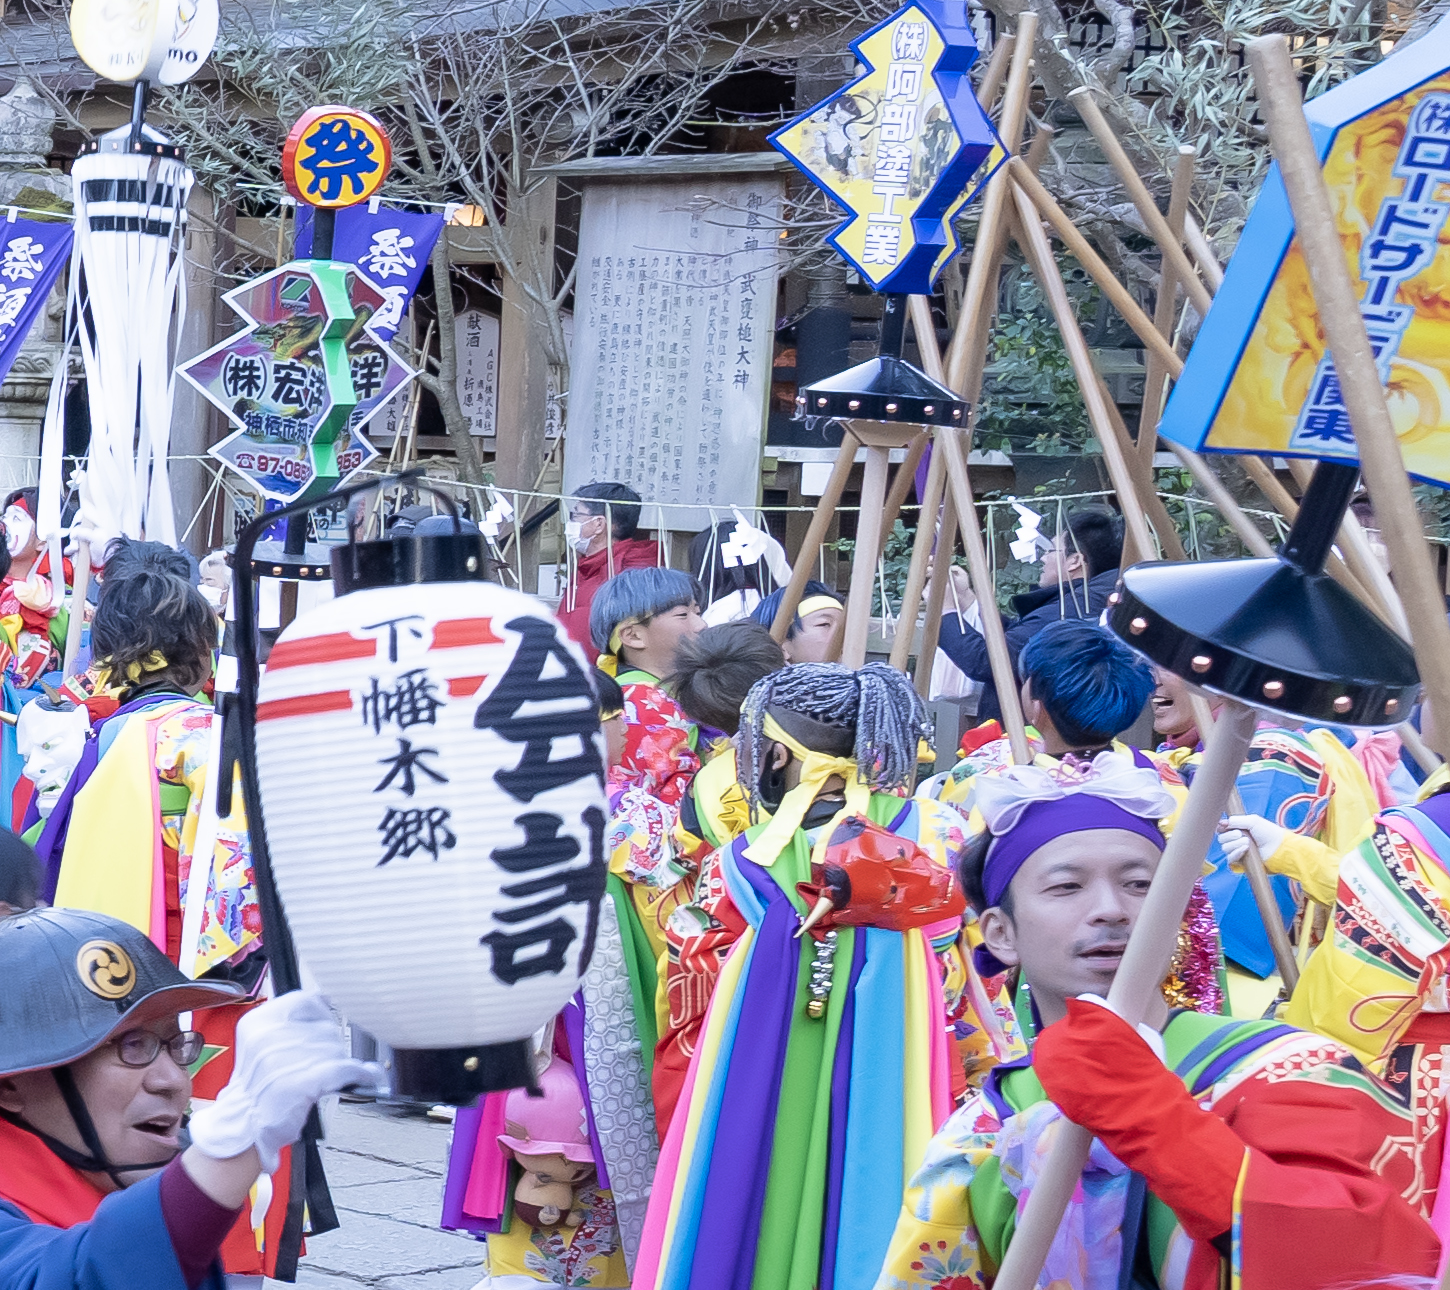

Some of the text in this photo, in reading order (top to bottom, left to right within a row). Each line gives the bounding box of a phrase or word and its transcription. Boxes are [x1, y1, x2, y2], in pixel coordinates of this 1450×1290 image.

[299, 118, 377, 199] 祭
[862, 21, 929, 265] (株)阿部塗工業
[362, 614, 456, 868] 下幡木郷
[474, 615, 608, 986] 会計
